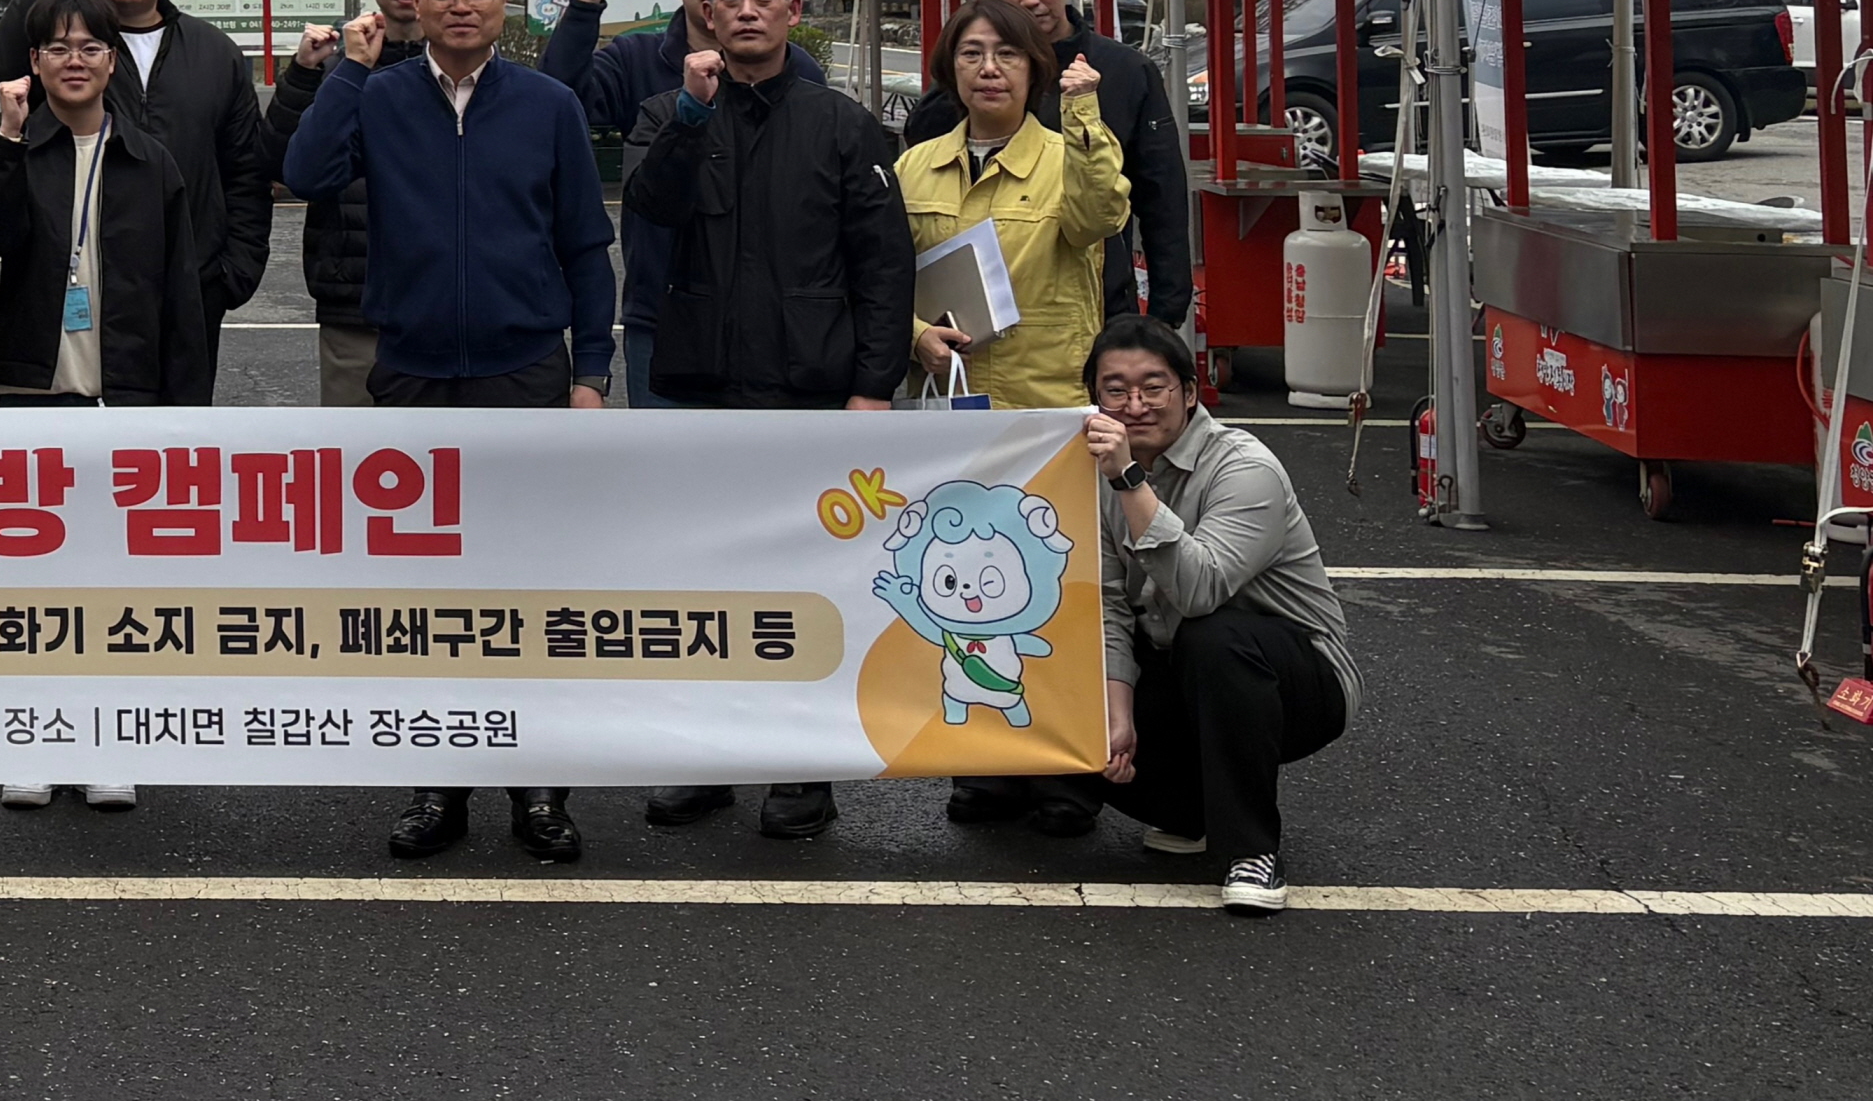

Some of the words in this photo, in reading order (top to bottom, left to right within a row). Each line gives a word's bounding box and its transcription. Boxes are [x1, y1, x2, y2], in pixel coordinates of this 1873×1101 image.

[112, 447, 462, 557] 캠페인
[818, 467, 907, 540] OK
[107, 606, 194, 655] 소지
[216, 606, 320, 659] 금지,
[339, 607, 524, 658] 폐쇄구간
[544, 607, 729, 659] 출입금지
[751, 610, 796, 661] 등
[4, 707, 76, 745] 장소
[116, 707, 225, 745] 대치면
[244, 707, 354, 746] 칠갑산
[369, 709, 518, 748] 장승공원
